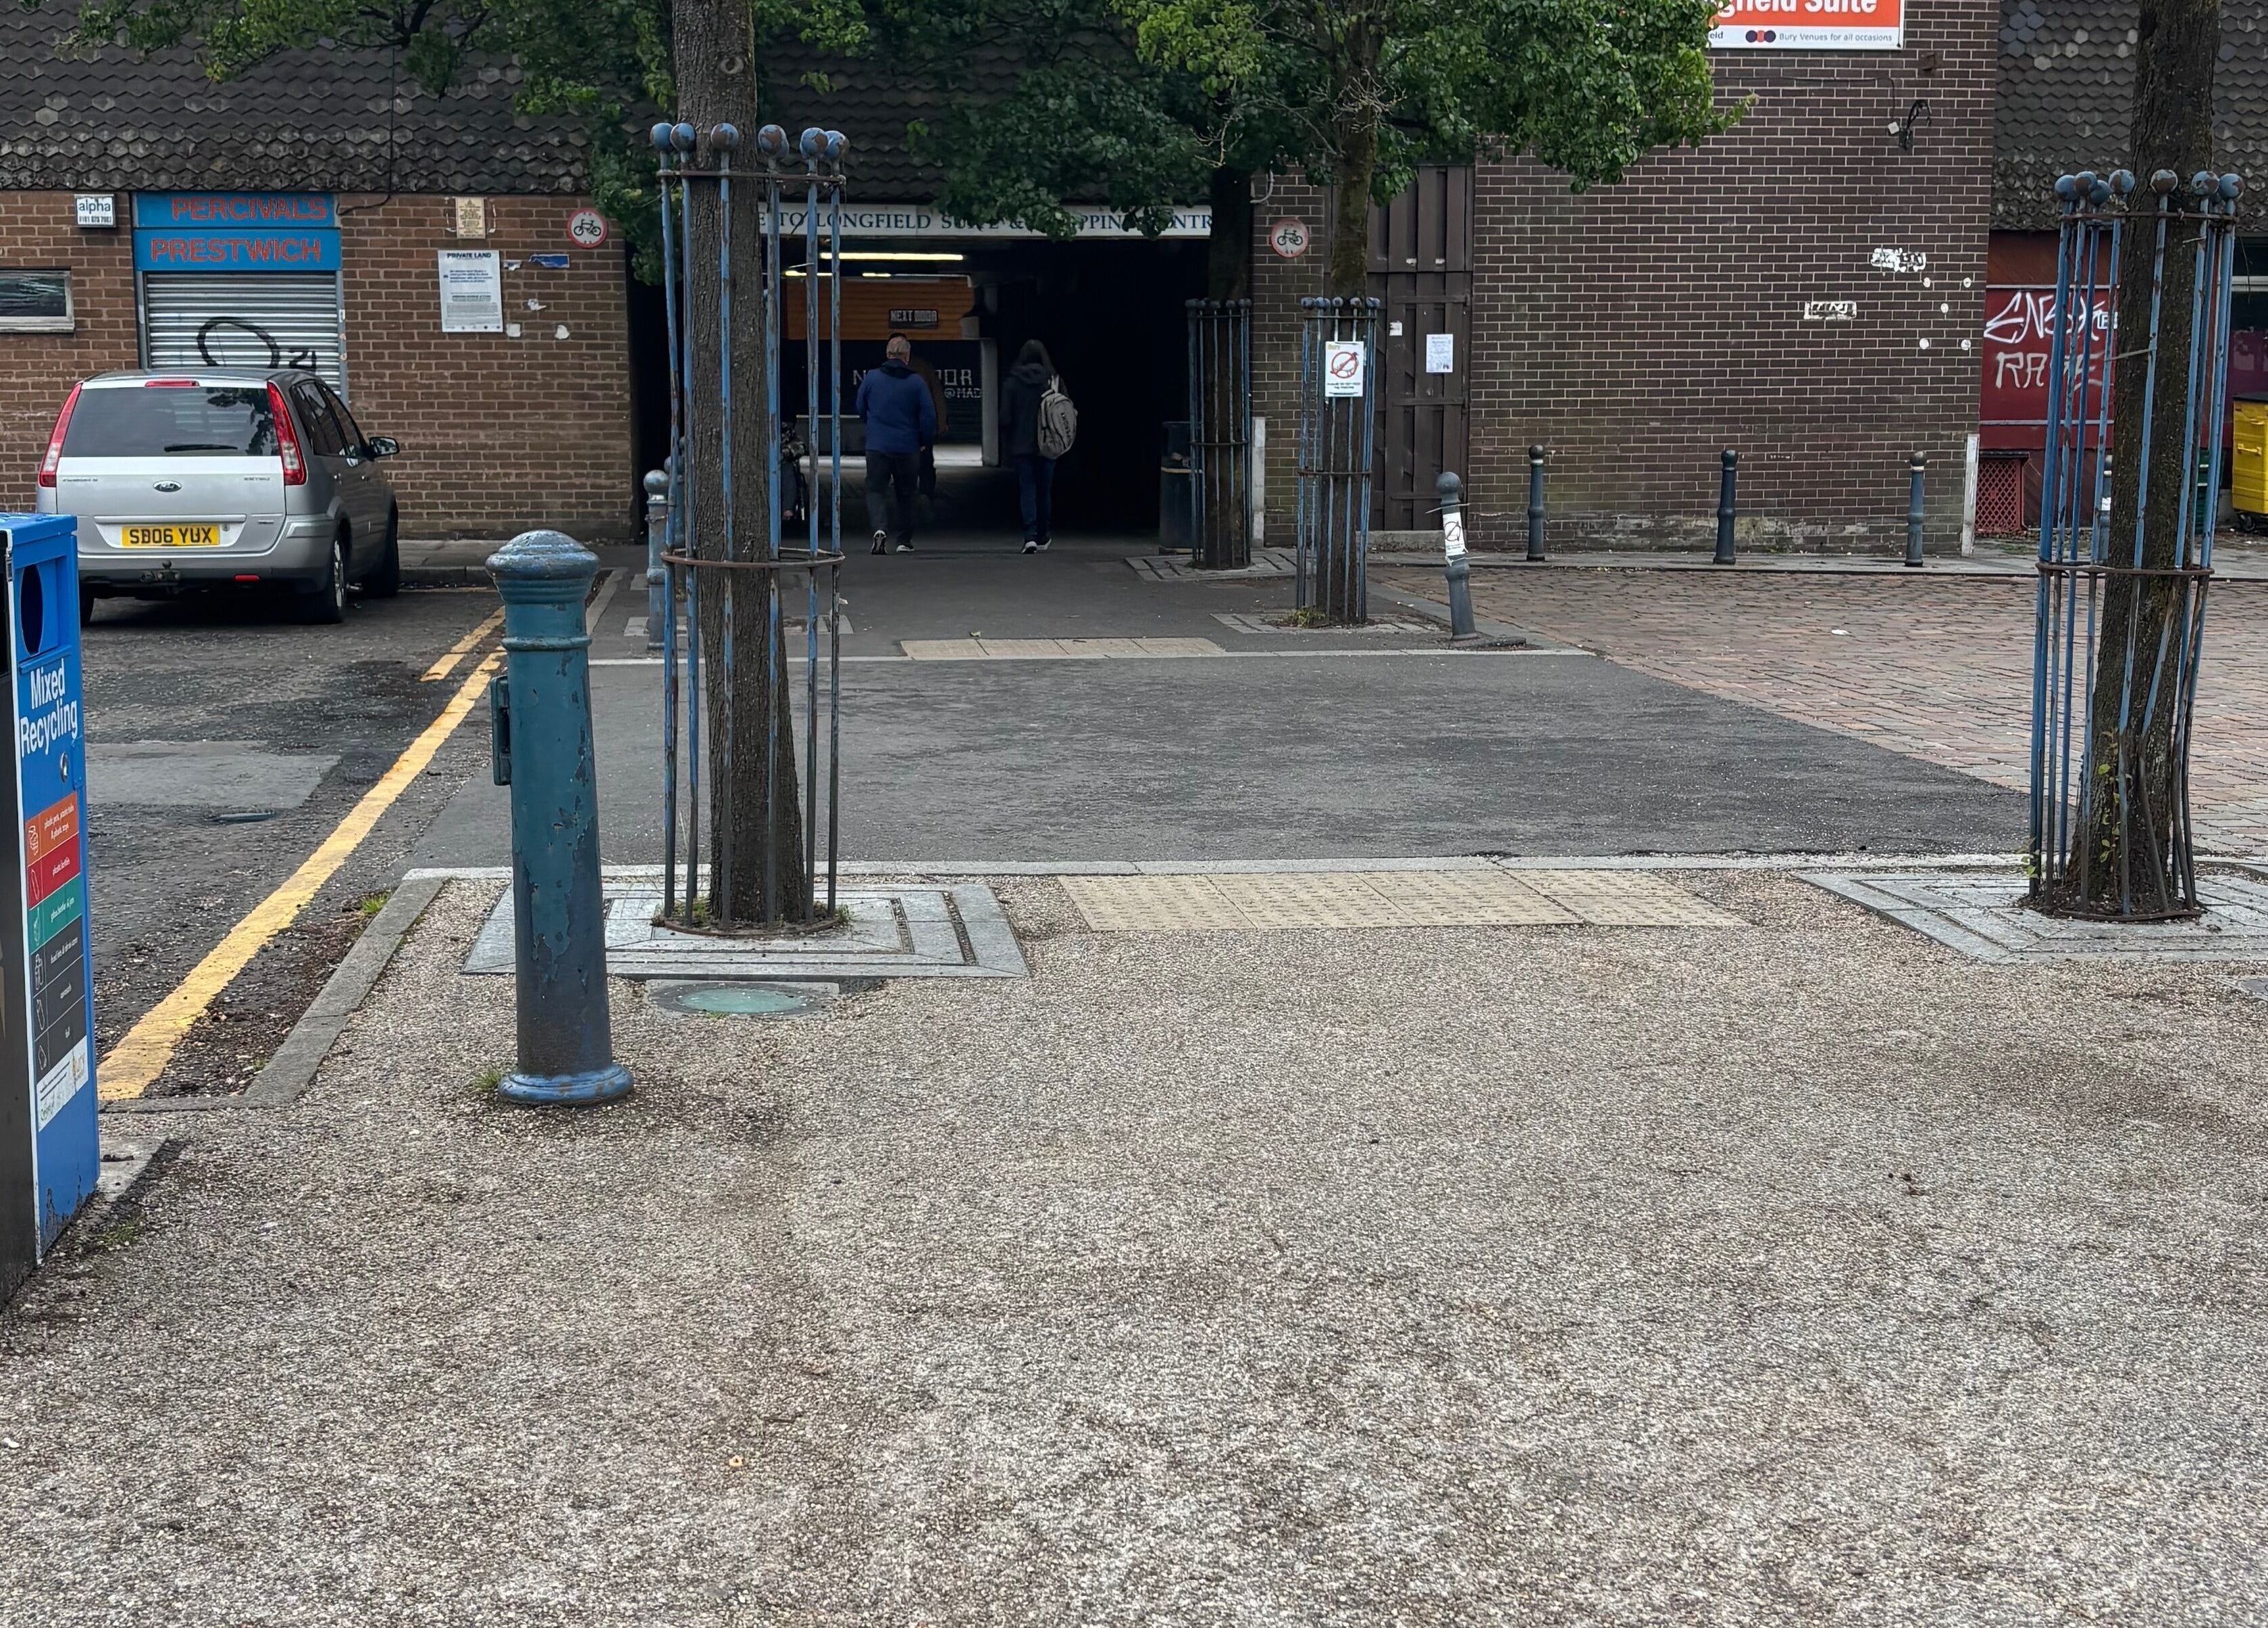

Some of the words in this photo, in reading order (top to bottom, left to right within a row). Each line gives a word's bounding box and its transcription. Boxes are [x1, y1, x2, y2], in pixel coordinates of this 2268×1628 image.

[1779, 33, 1797, 41] Bury
[79, 199, 111, 214] alpha
[151, 238, 321, 261] PRESTWICH
[178, 528, 212, 543] YUX
[30, 657, 66, 710] Mixed
[20, 698, 78, 758] Recycling
